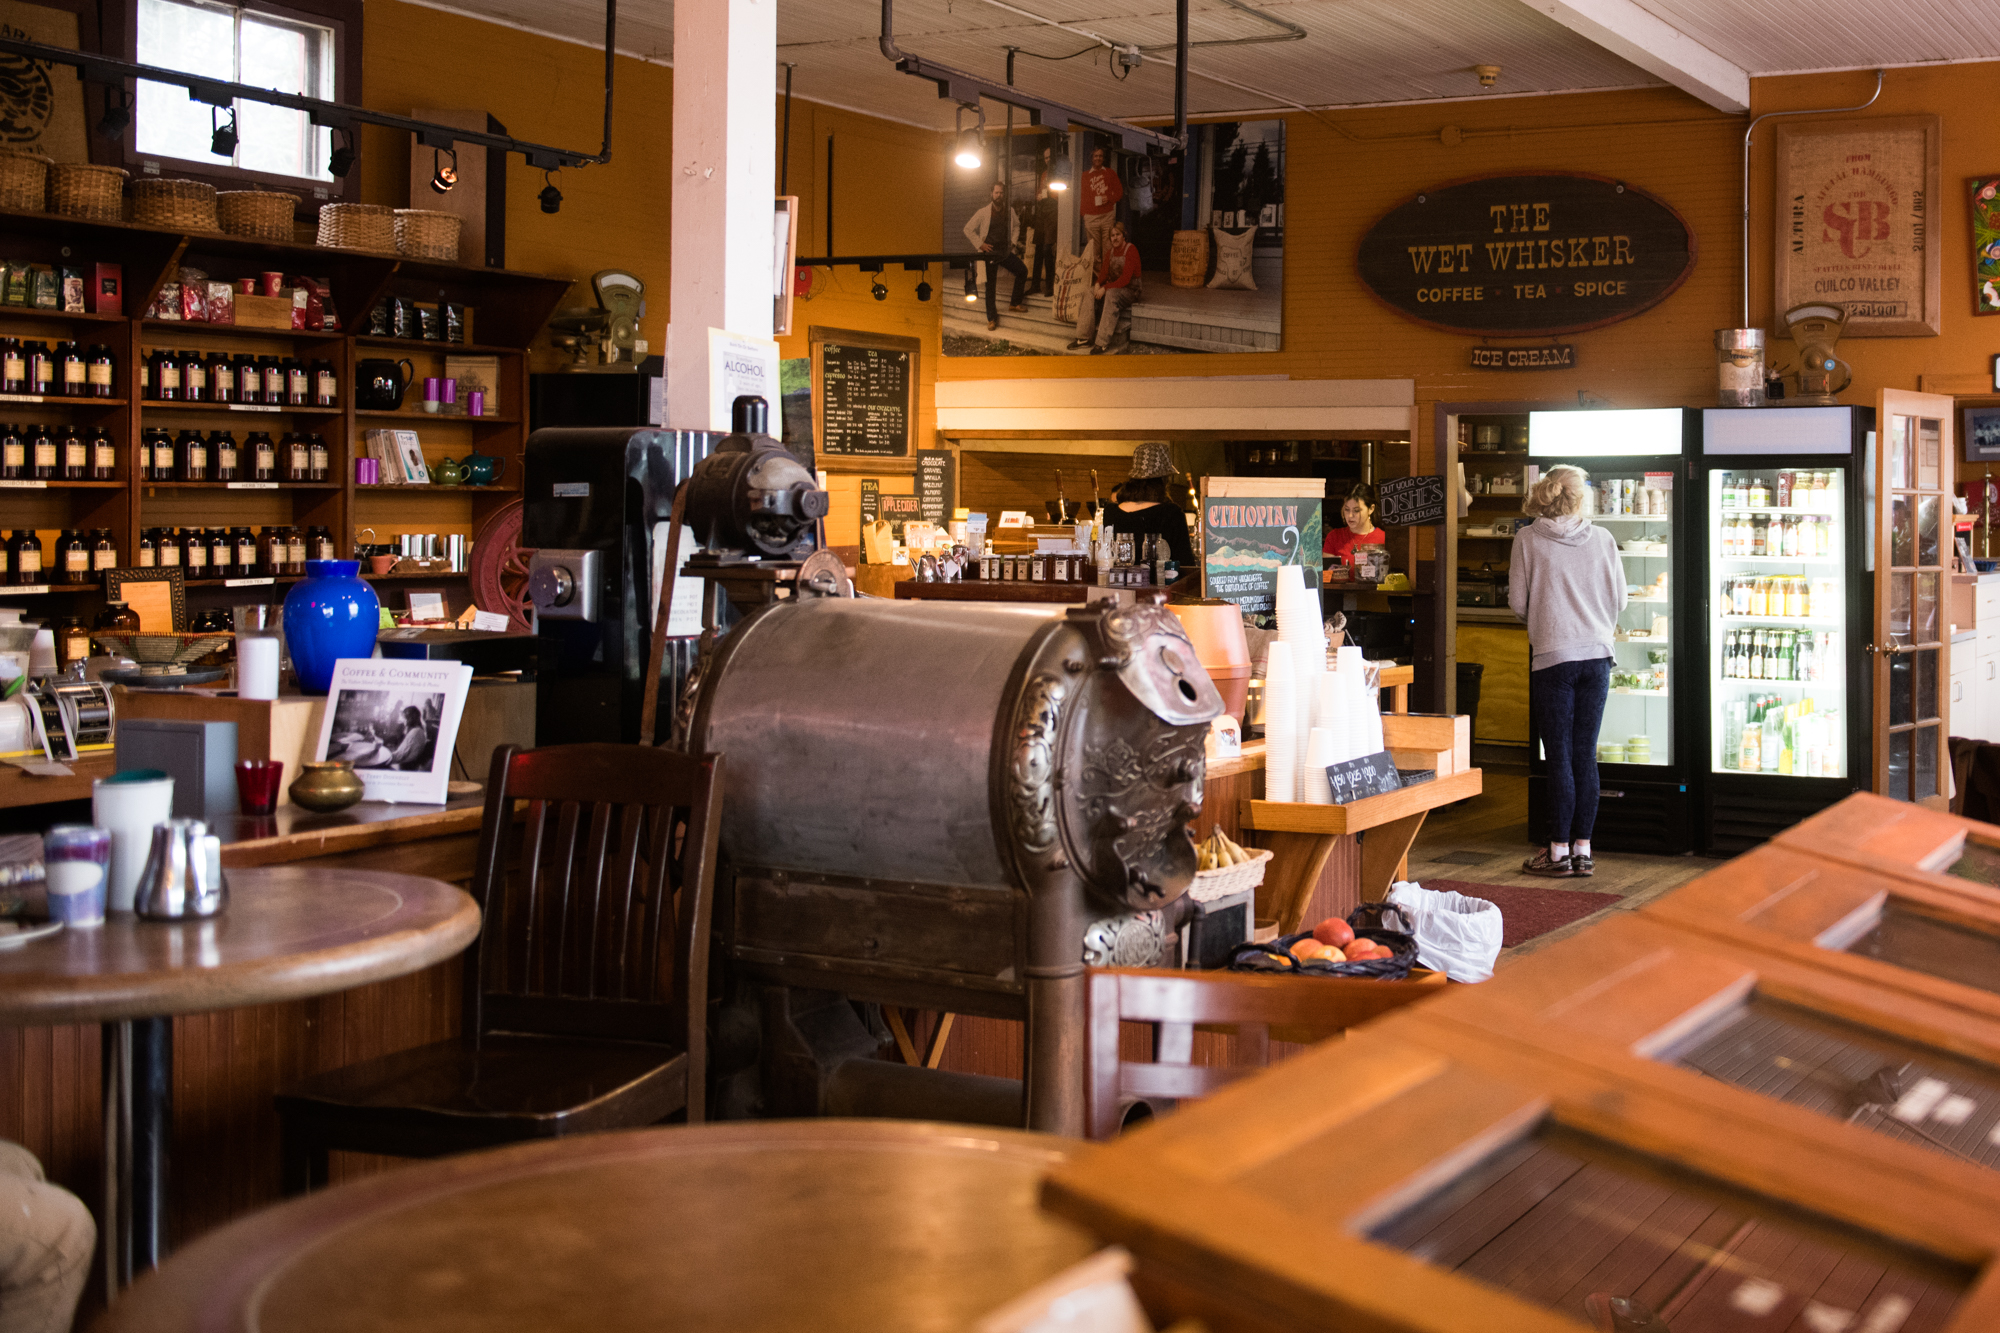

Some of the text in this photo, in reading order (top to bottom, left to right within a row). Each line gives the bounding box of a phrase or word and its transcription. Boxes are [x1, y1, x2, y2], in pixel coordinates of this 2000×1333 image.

[1490, 203, 1550, 234] THE
[1408, 235, 1635, 274] WET WHISKER
[1416, 281, 1627, 302] COFFEE TEA SPICE
[1815, 277, 1901, 293] CUILCO VALLEY
[1472, 348, 1571, 367] ICE CREAM
[724, 360, 764, 378] ALCOHOL
[863, 482, 878, 491] TEA
[1381, 479, 1415, 495] PUT YOUR
[883, 500, 901, 512] APPLE
[901, 500, 918, 512] CIDER
[1401, 506, 1443, 523] HERE PLEASE
[1208, 505, 1298, 527] ETHIOPIAN
[1227, 575, 1238, 583] FROM
[379, 667, 386, 677] &
[389, 668, 450, 680] COMMUNITY
